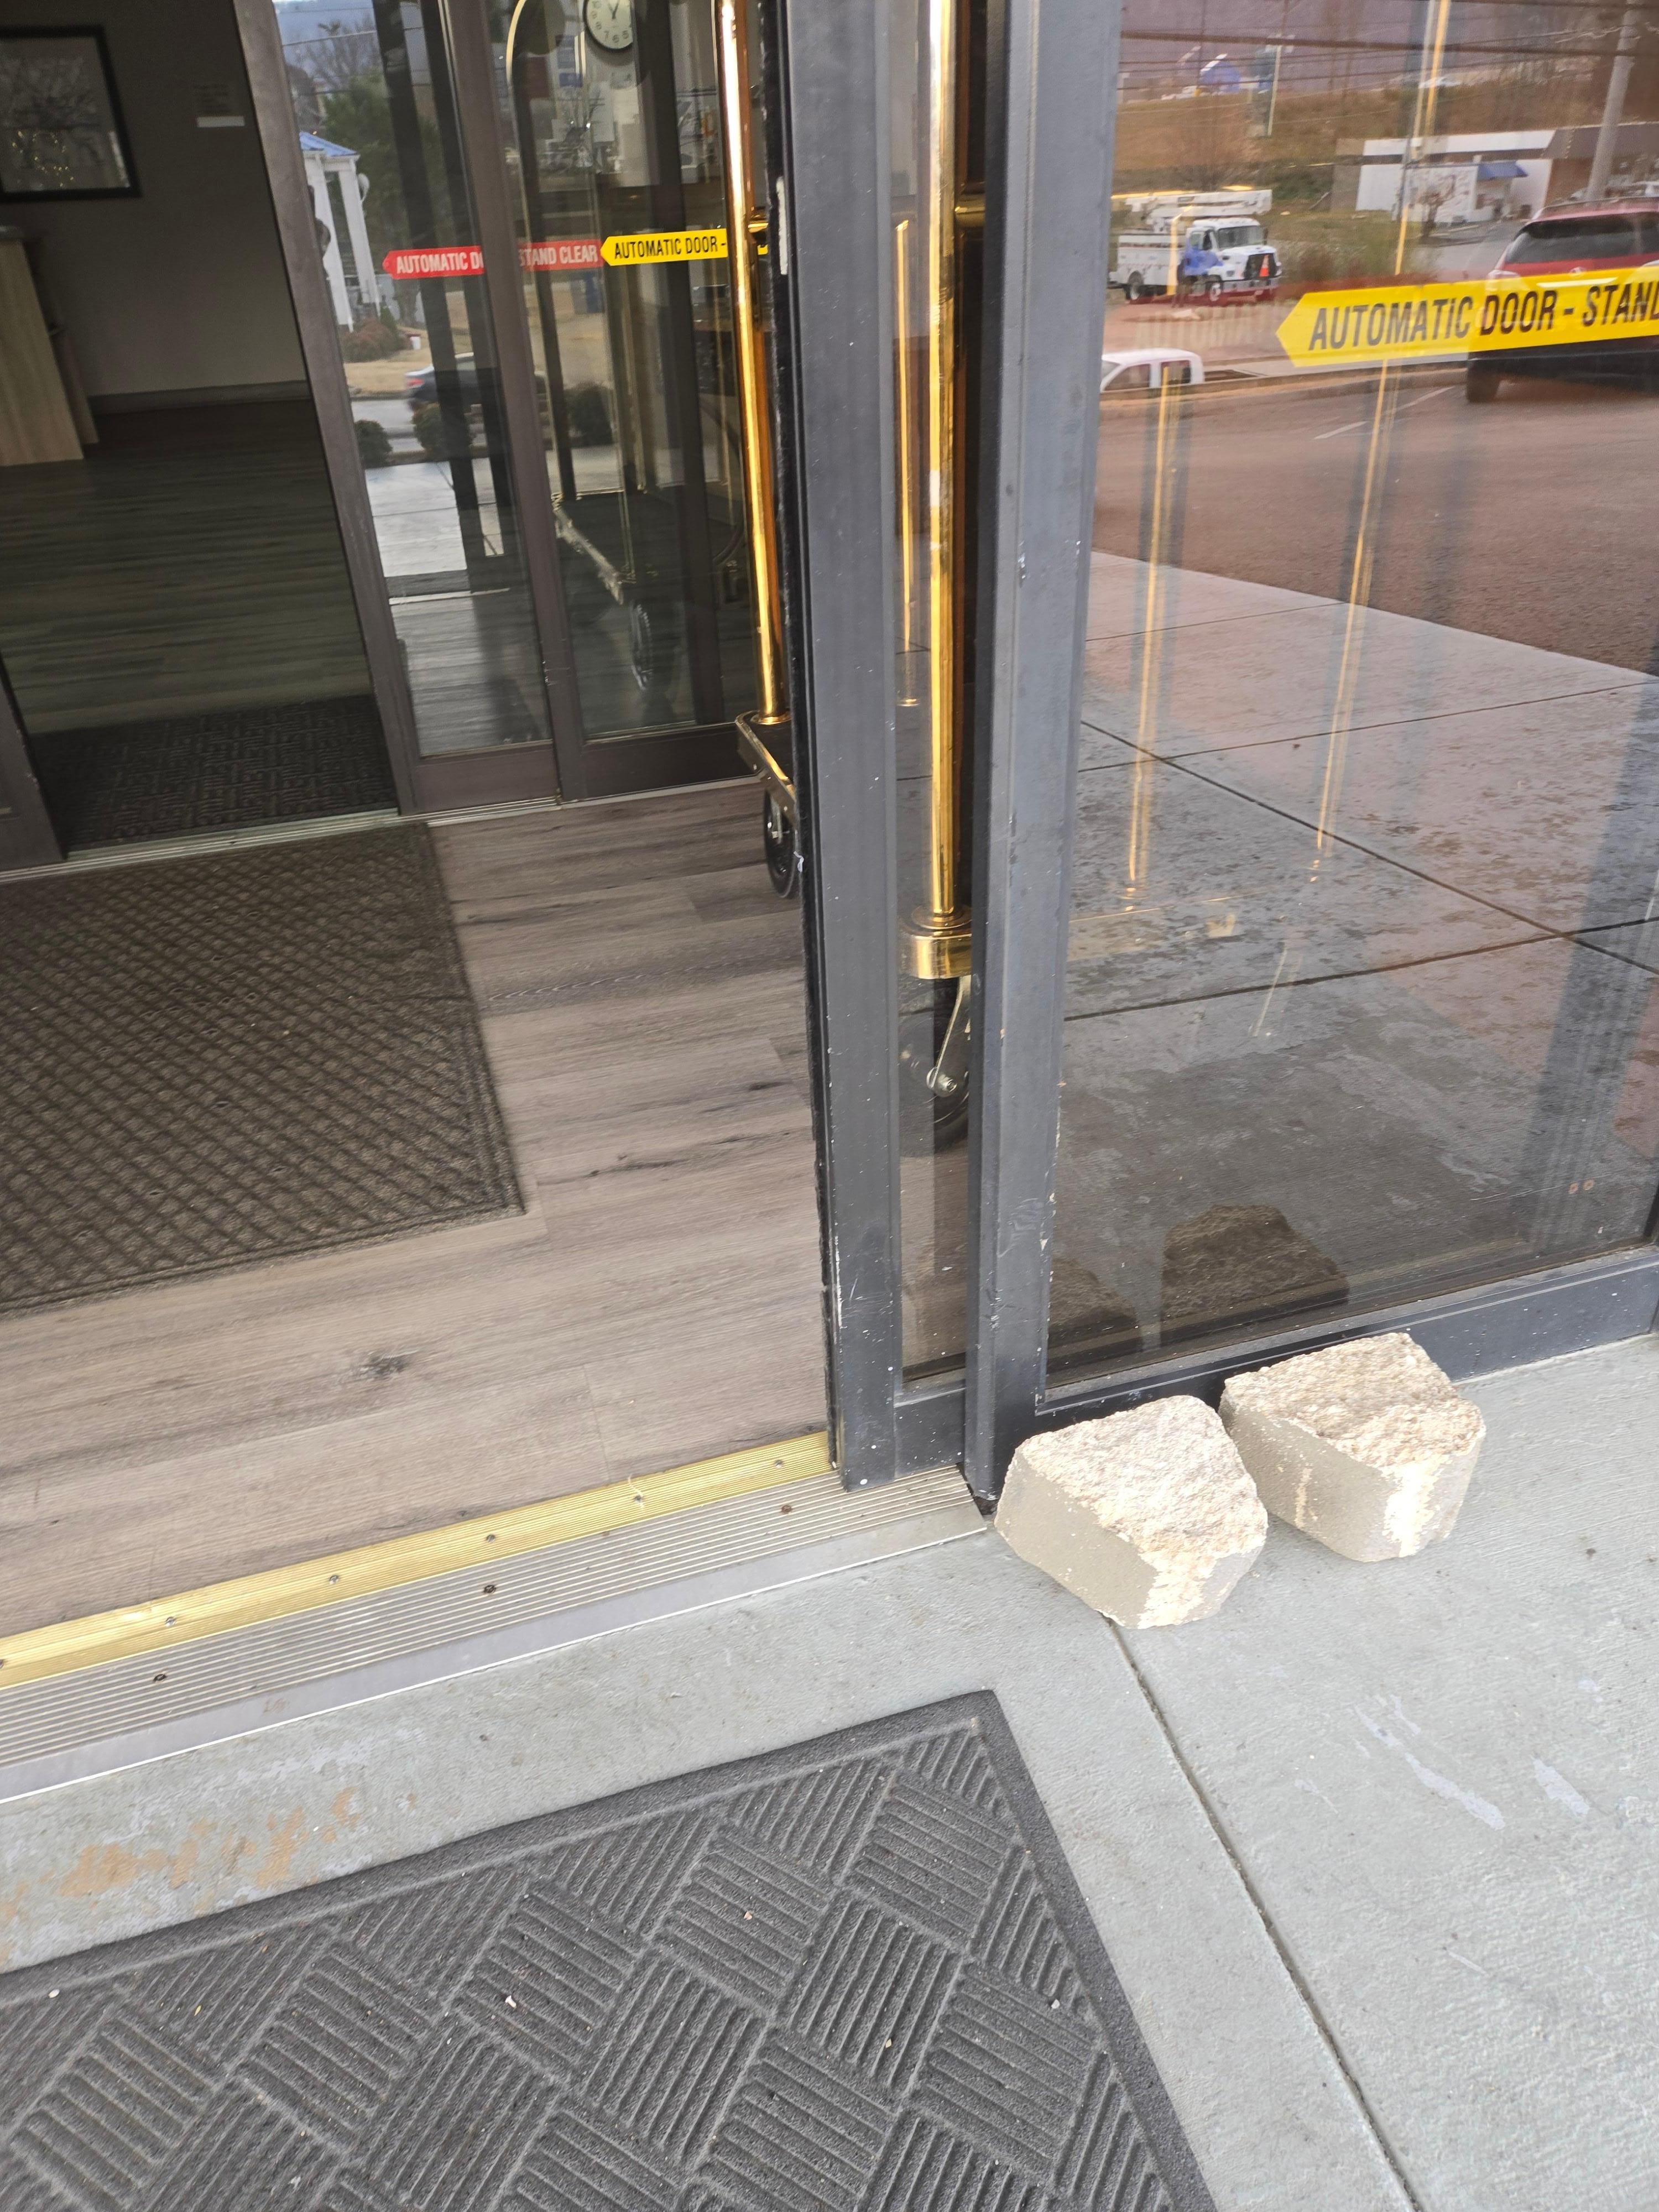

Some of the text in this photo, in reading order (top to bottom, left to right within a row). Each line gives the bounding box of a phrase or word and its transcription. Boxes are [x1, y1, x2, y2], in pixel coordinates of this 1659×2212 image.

[397, 252, 468, 274] AUTOMATIC
[559, 245, 598, 264] CLEAR
[614, 238, 681, 259] AUTOMATIC
[685, 236, 718, 254] DOOR
[1308, 296, 1474, 351] AUTOMATIC
[1480, 290, 1558, 336] DOOR
